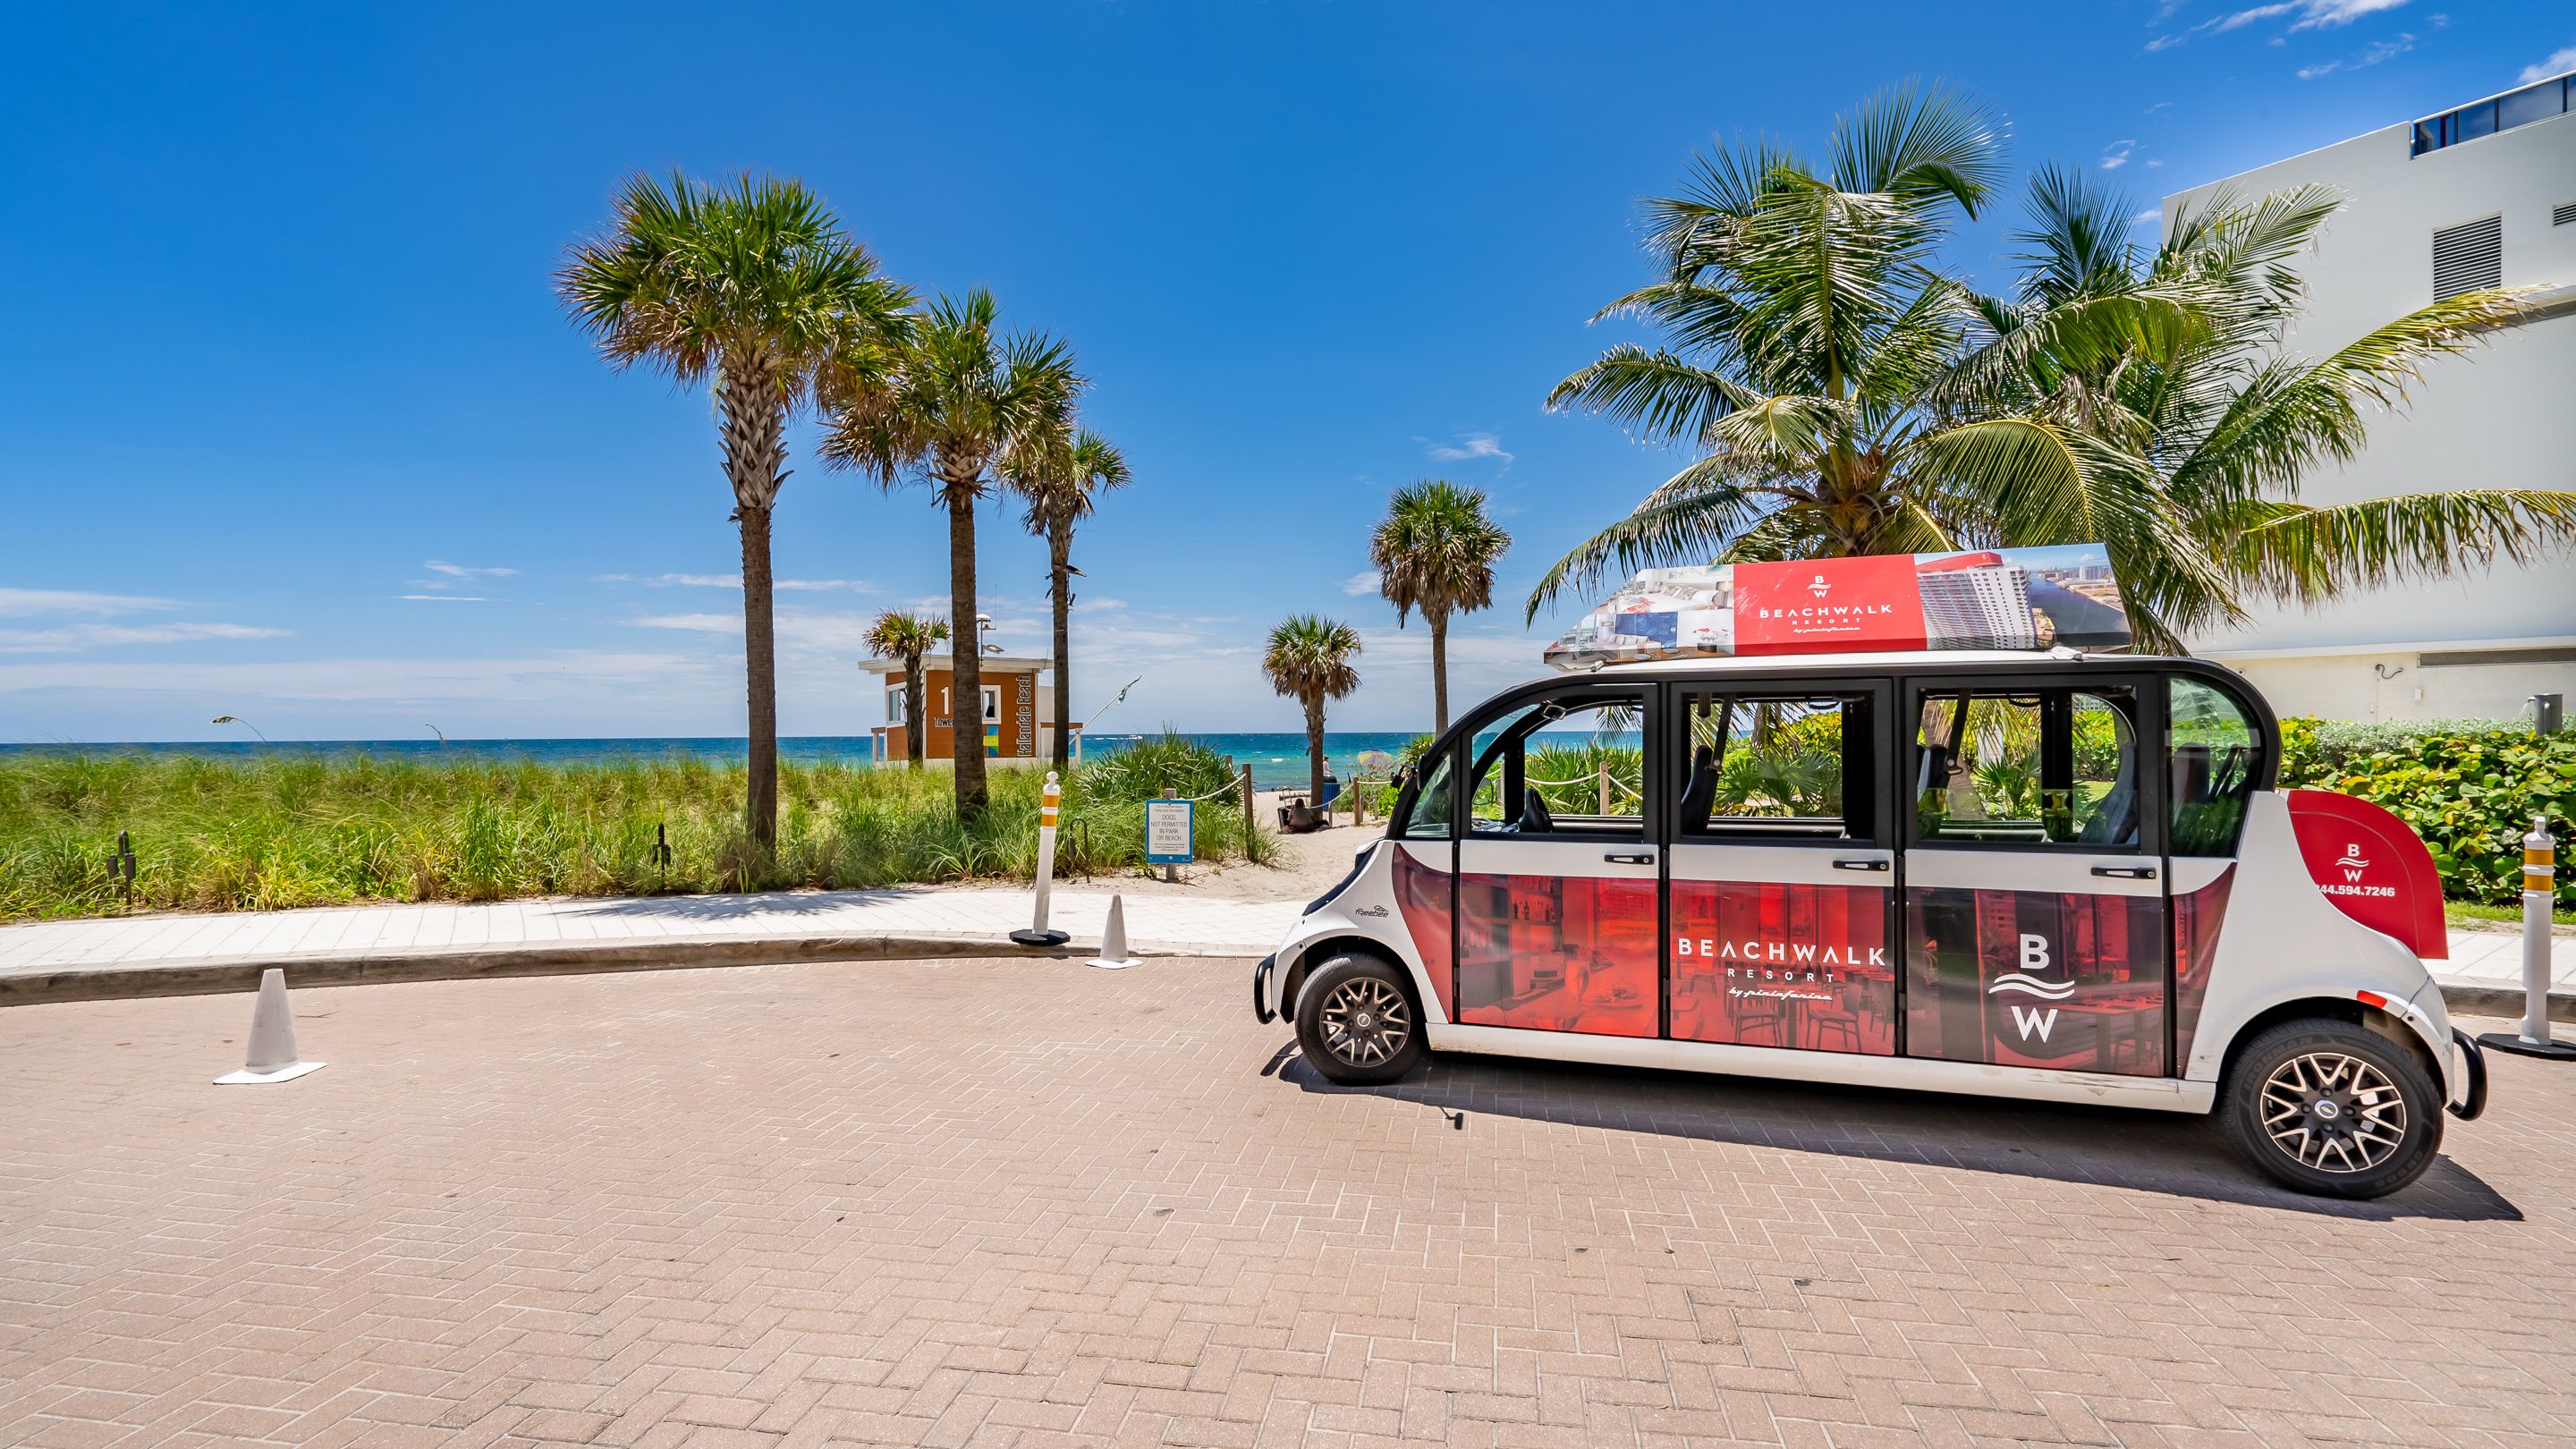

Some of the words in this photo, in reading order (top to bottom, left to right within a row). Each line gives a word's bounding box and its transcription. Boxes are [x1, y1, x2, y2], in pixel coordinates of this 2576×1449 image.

[1815, 575, 1825, 584] B
[1814, 590, 1827, 598] W
[1759, 604, 1893, 619] BEACHWALK
[1792, 617, 1861, 625] RESORT
[1016, 673, 1031, 705] Beach
[941, 686, 949, 715] 1
[1016, 706, 1032, 758] Hallandale
[2347, 843, 2360, 857] B
[2343, 869, 2363, 883] W
[1678, 937, 1886, 966] BEACHWALK
[2019, 933, 2050, 970] B
[1727, 968, 1834, 983] RESORT
[2010, 1005, 2059, 1044] W
